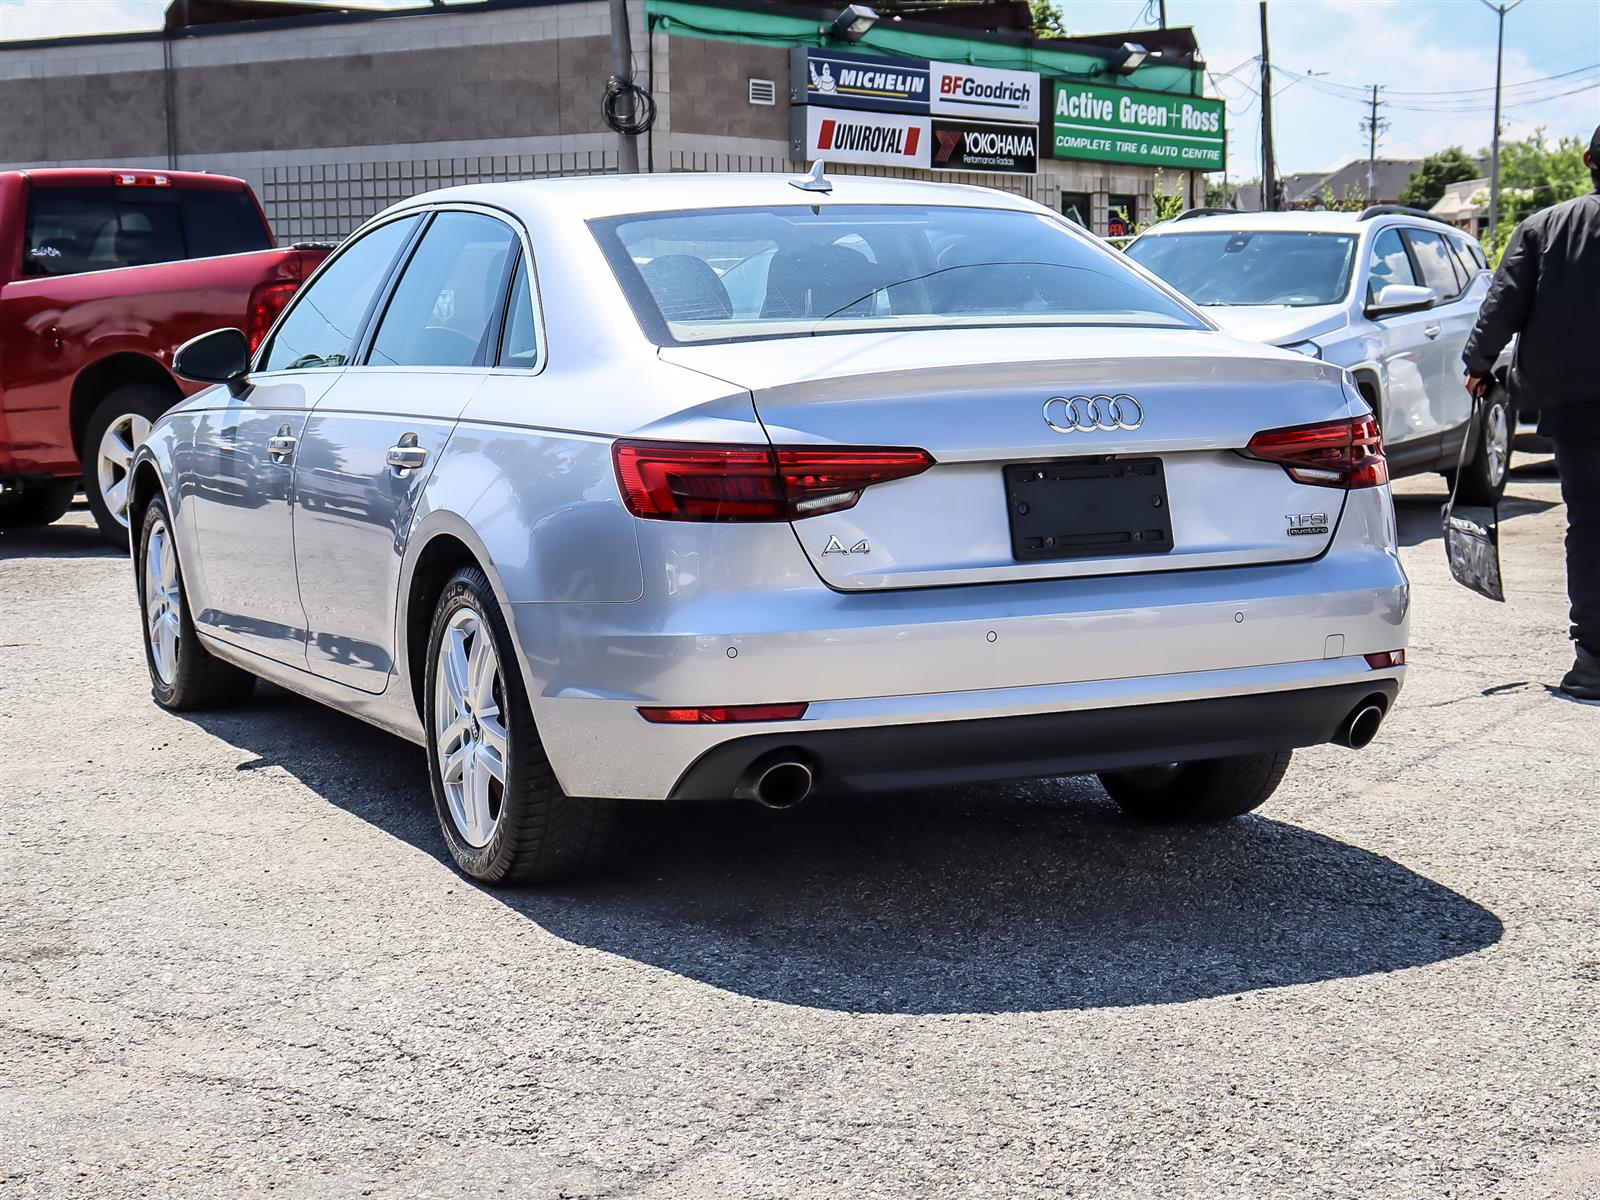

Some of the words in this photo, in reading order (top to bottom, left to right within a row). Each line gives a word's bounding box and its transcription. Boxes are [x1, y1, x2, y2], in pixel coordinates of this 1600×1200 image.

[839, 69, 925, 93] MICHELIN
[940, 75, 1030, 102] BFGoodrich
[1056, 89, 1113, 121] Active
[834, 123, 903, 154] UNIROYAL
[963, 132, 1035, 156] YOKOHAMA
[1056, 136, 1112, 151] COMPLETE
[1116, 141, 1138, 153] TIRE
[1140, 143, 1148, 154] &
[1151, 145, 1178, 157] AUTO
[1181, 147, 1221, 160] CENTRE
[1285, 513, 1328, 527] TFSI
[1289, 527, 1328, 536] quattro
[821, 535, 870, 557] A4
